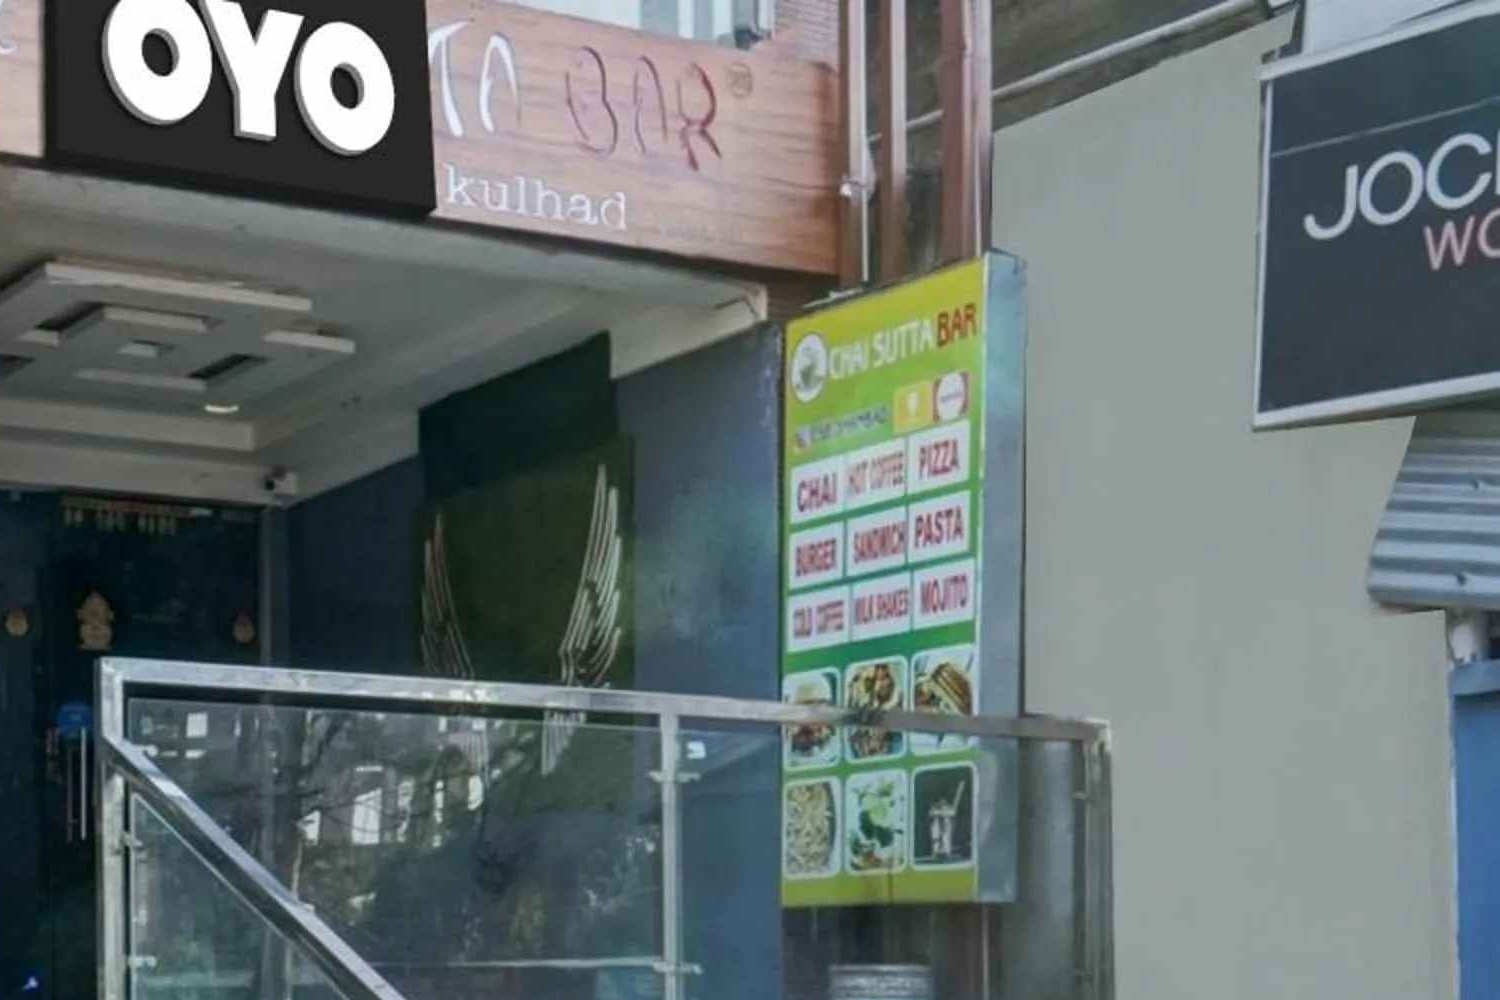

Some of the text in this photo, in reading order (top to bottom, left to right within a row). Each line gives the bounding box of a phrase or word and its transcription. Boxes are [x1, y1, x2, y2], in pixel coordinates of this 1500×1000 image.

[102, 0, 395, 156] OYO
[563, 45, 723, 172] BAR
[444, 164, 627, 231] kulhad
[1303, 130, 1500, 240] JOC
[828, 302, 977, 381] CHAI SUTTA BAR
[918, 437, 960, 481] PIZZA
[797, 472, 837, 513] CHAI
[853, 521, 906, 565] SANDWICH
[913, 505, 964, 549] PASTA
[796, 537, 837, 578] BURGER
[920, 573, 968, 615] MOJITO
